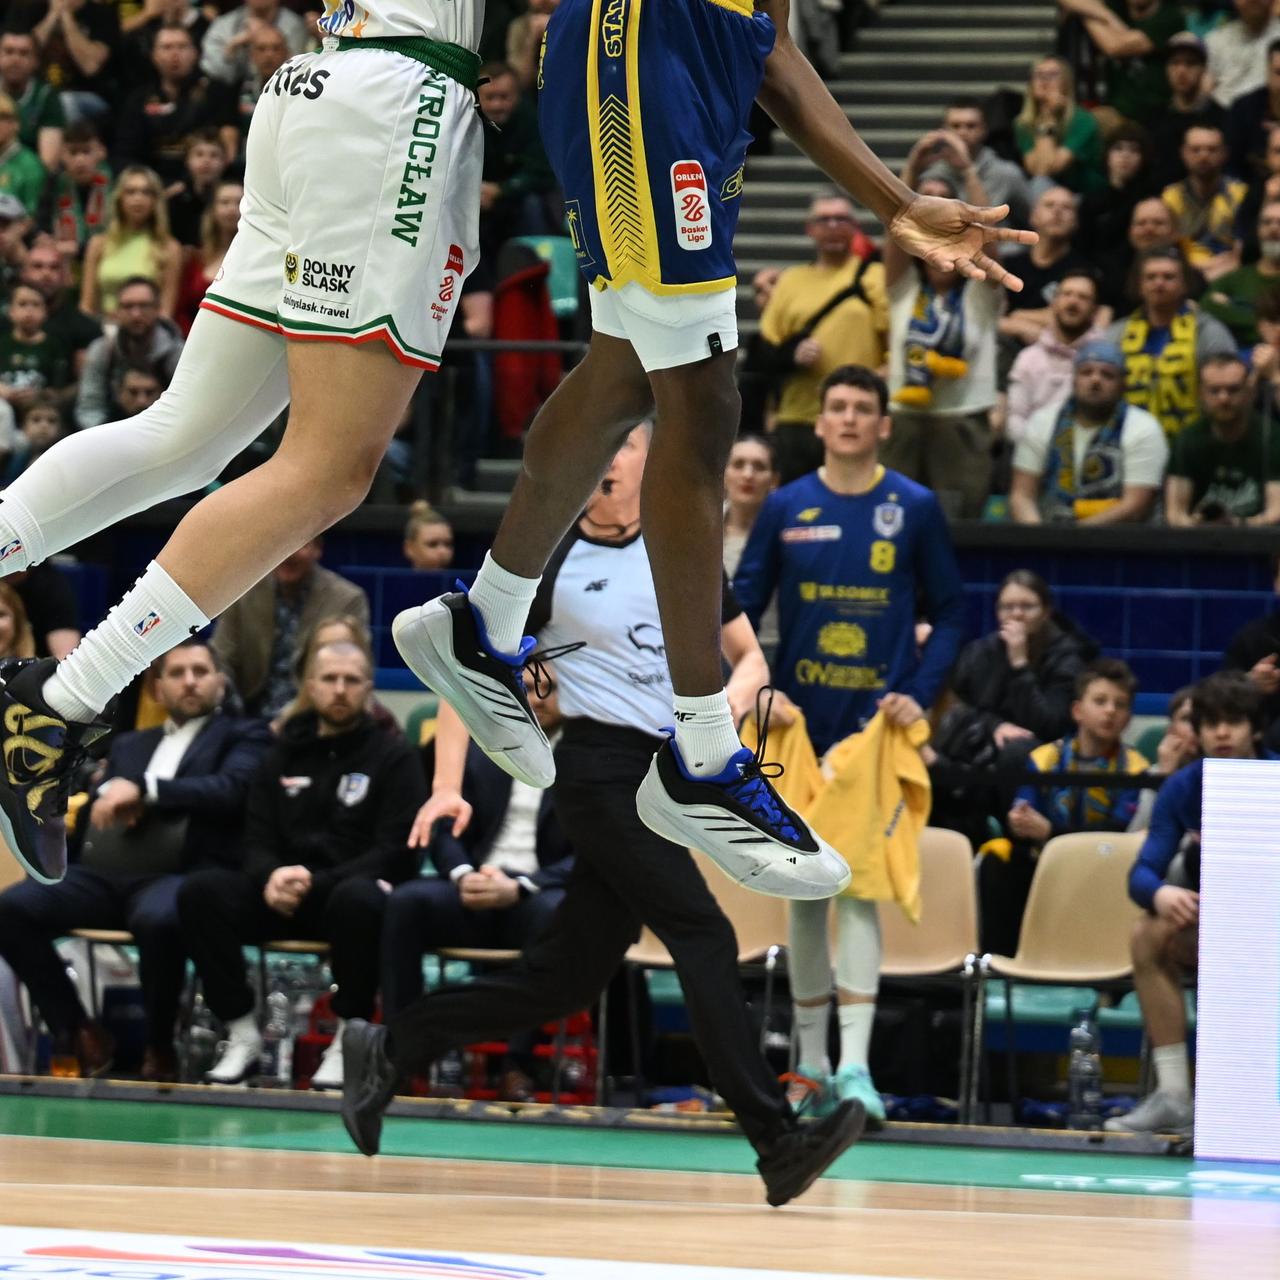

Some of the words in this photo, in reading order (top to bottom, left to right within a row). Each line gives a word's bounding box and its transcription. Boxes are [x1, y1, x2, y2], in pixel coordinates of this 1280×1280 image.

[675, 172, 703, 182] ORLEN
[681, 225, 709, 234] Basket
[687, 233, 705, 243] Liga
[303, 258, 355, 279] DOLNY
[302, 270, 350, 294] ŚLĄSK
[283, 293, 350, 319] dolnyslask.travel
[870, 540, 897, 574] 8
